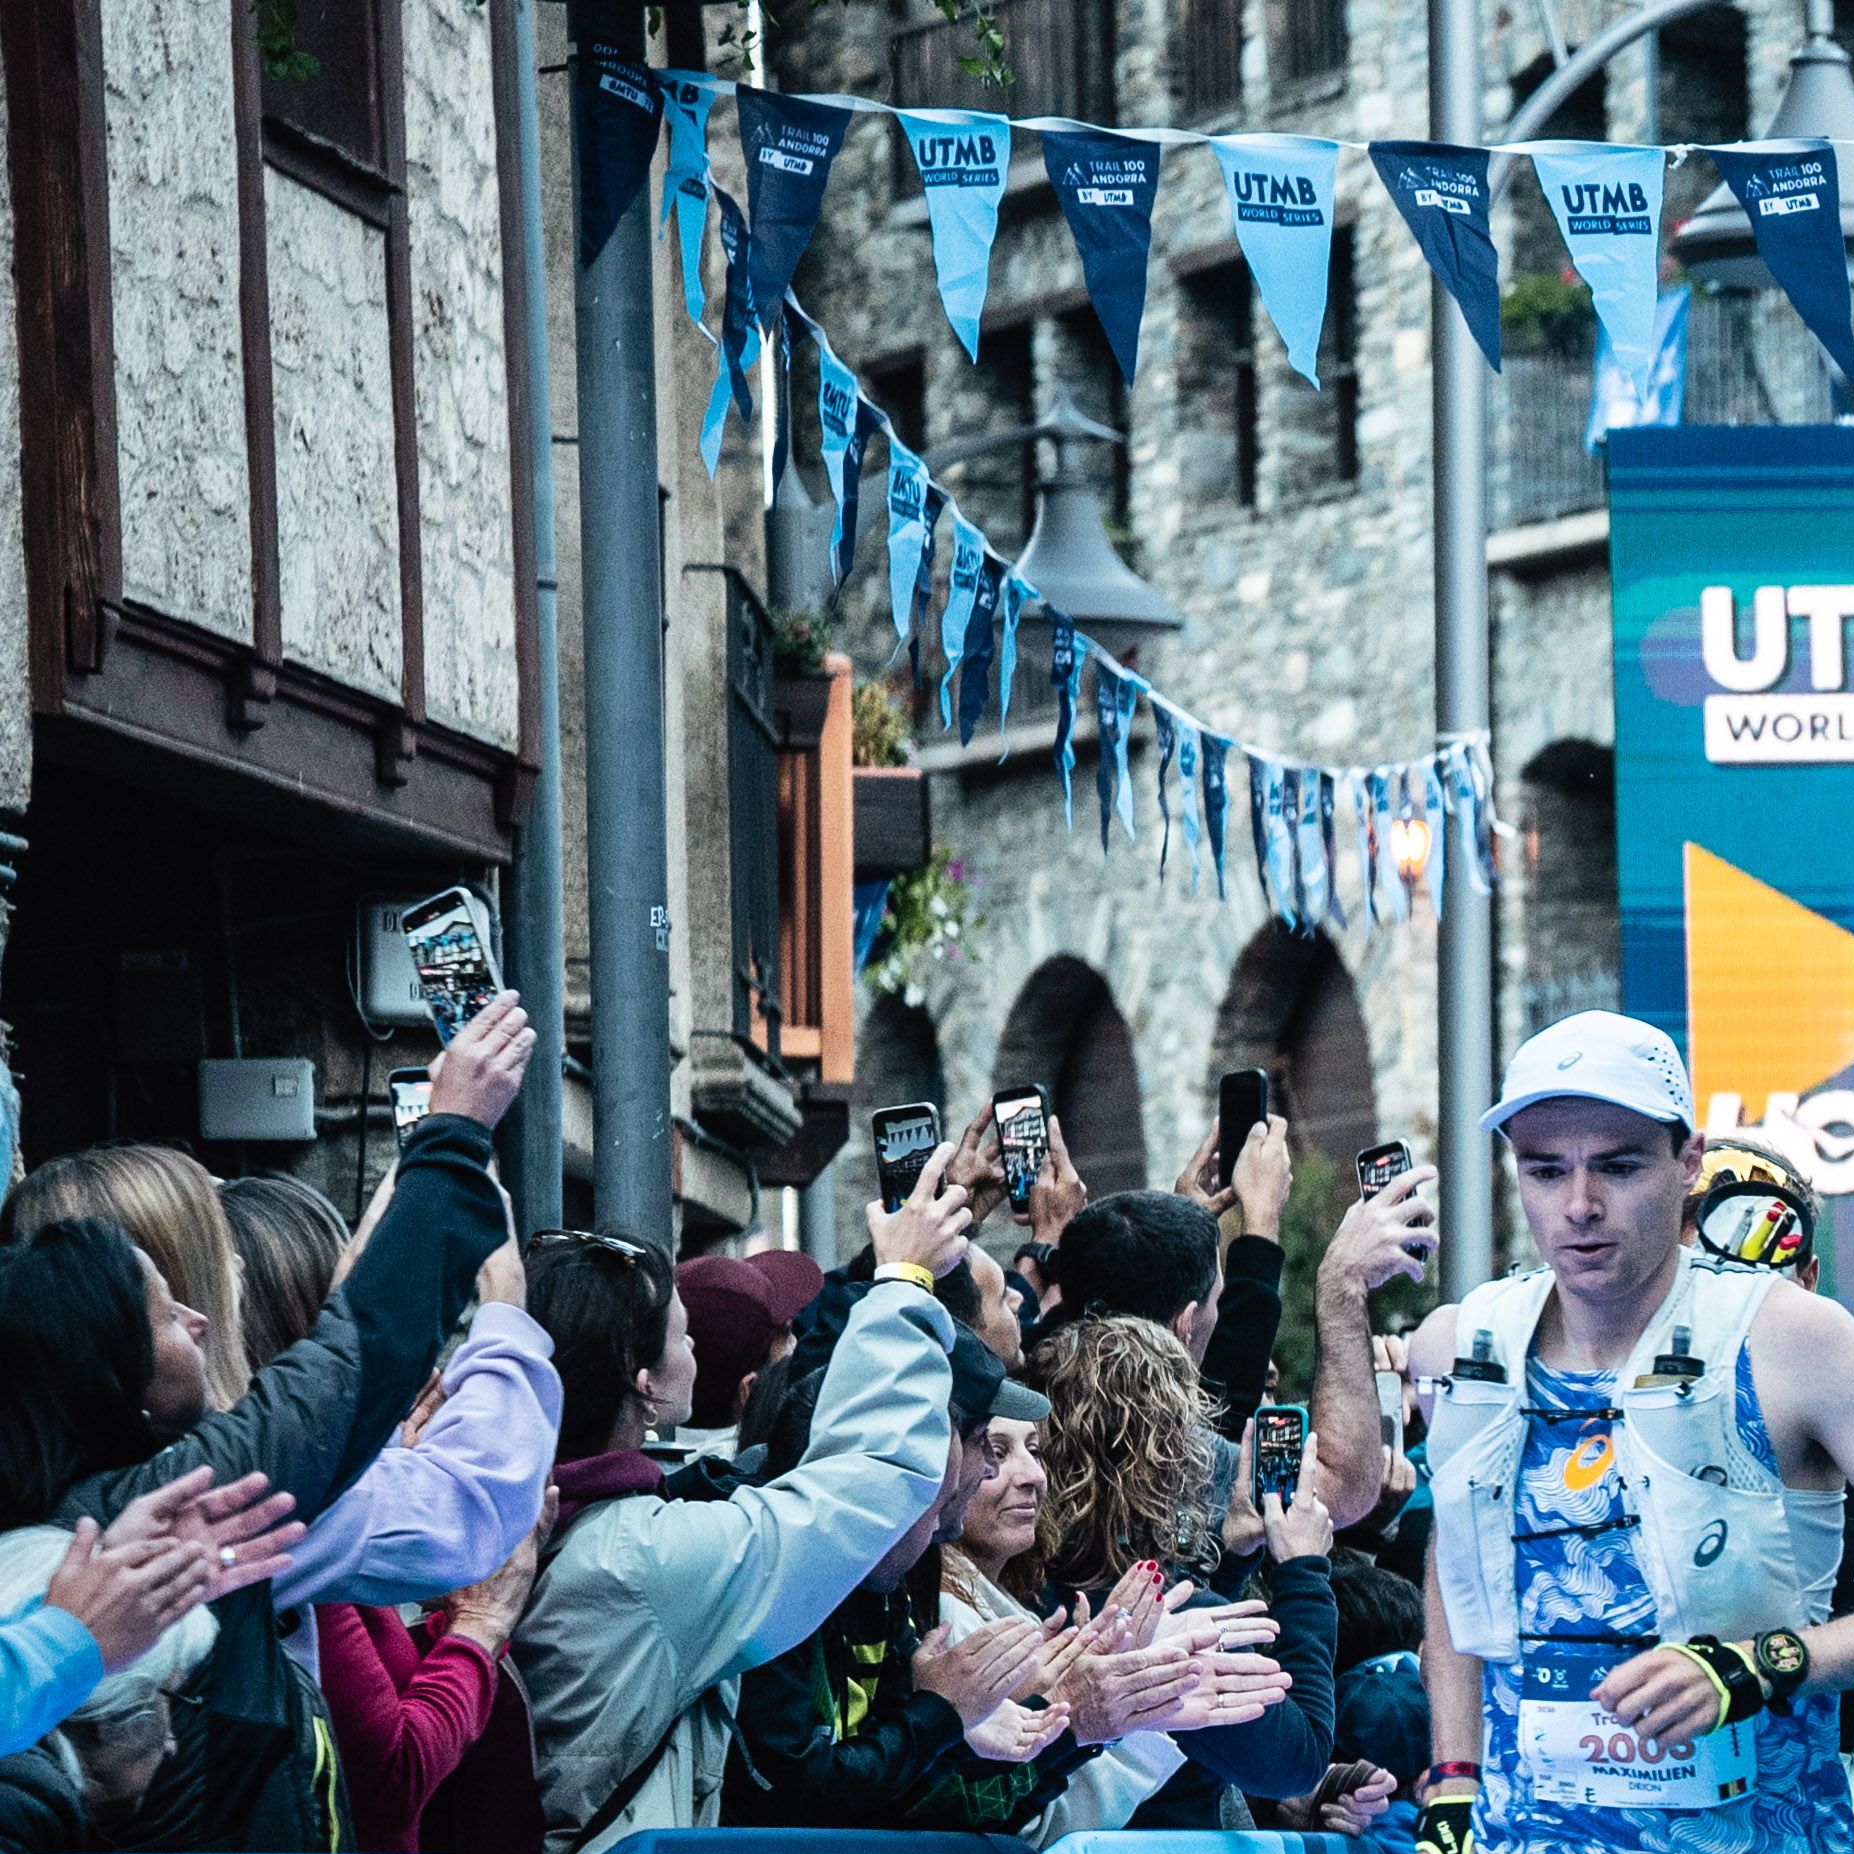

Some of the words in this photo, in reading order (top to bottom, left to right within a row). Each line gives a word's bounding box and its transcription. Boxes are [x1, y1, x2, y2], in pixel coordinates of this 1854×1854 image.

[918, 135, 996, 168] UTMB
[1123, 160, 1145, 172] 100
[1801, 162, 1821, 175] 100
[1091, 173, 1147, 184] ANDORRA
[1772, 175, 1827, 194] ANDORRA
[1234, 171, 1317, 206] UTMB
[1561, 181, 1648, 215] UTMB
[1593, 1765, 1697, 1781] MAXIMILIEN
